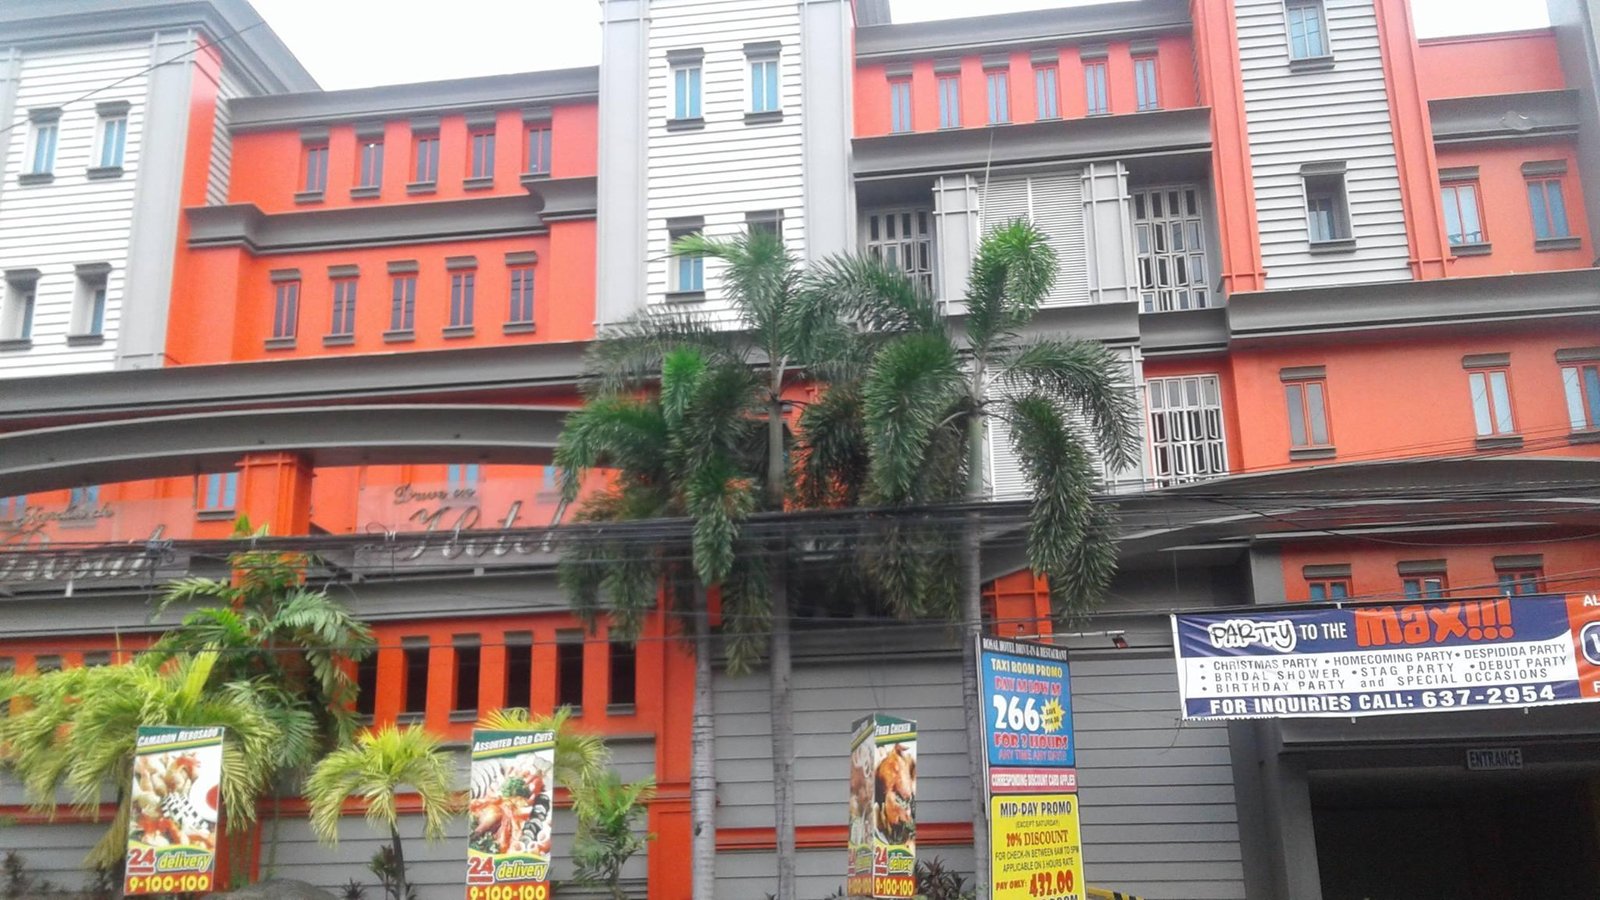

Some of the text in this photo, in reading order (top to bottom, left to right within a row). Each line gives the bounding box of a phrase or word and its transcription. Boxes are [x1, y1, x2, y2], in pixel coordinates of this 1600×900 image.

[1209, 620, 1295, 651] PARTY
[1299, 623, 1318, 640] TO
[1321, 622, 1347, 640] THE
[1213, 643, 1566, 671] CHRISTMAS PARTY HOMECOMING PARTY DESPIDIDA PARTY
[991, 658, 1063, 678] TAXI ROOM PROMO
[1214, 655, 1567, 683] BRIDAL SHOWER STAG PARTY DEBUT PARTY
[1216, 668, 1549, 693] BIRTHDAY PARTY and SPECIAL OCCASIONS
[1210, 685, 1555, 714] FOR INQUIRIES CALL: 637-2954
[993, 694, 1040, 731] 266
[137, 733, 177, 747] CAMARON
[473, 732, 553, 752] ASSORTED COLD CUTS
[994, 732, 1019, 747] FOR
[1470, 749, 1520, 768] ENTRANCE
[1000, 801, 1072, 817] MID-DAY PROMO
[1024, 830, 1068, 846] DISCOUNT
[128, 848, 155, 866] 24
[159, 853, 211, 872] delivery
[875, 847, 888, 865] 24
[995, 851, 1006, 860] FOR
[1031, 848, 1054, 858] BETWEEN
[468, 857, 494, 875] 24
[497, 862, 548, 881] delivery
[1003, 862, 1034, 873] APPLICABLE
[129, 875, 209, 892] 9-100-100
[469, 885, 546, 900] 9-100-100
[875, 877, 914, 897] 9-100-100
[996, 881, 1008, 891] PAY
[1029, 869, 1074, 897] 432.00
